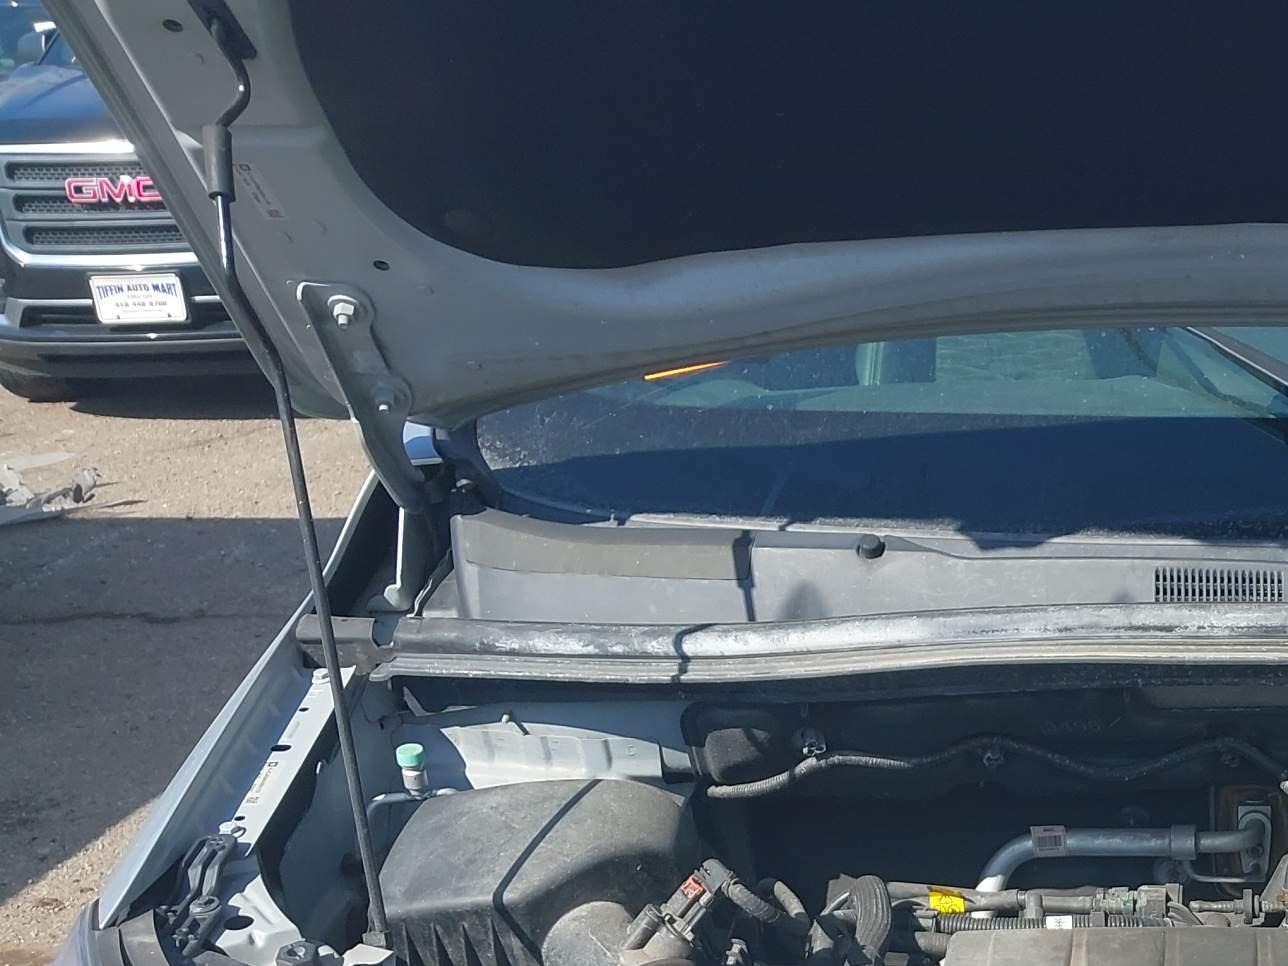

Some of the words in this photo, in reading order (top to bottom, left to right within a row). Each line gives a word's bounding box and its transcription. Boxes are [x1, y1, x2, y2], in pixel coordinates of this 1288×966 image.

[65, 175, 161, 203] GMC
[96, 284, 124, 300] TIFFIN
[126, 283, 150, 292] AUTO
[151, 283, 178, 297] MART
